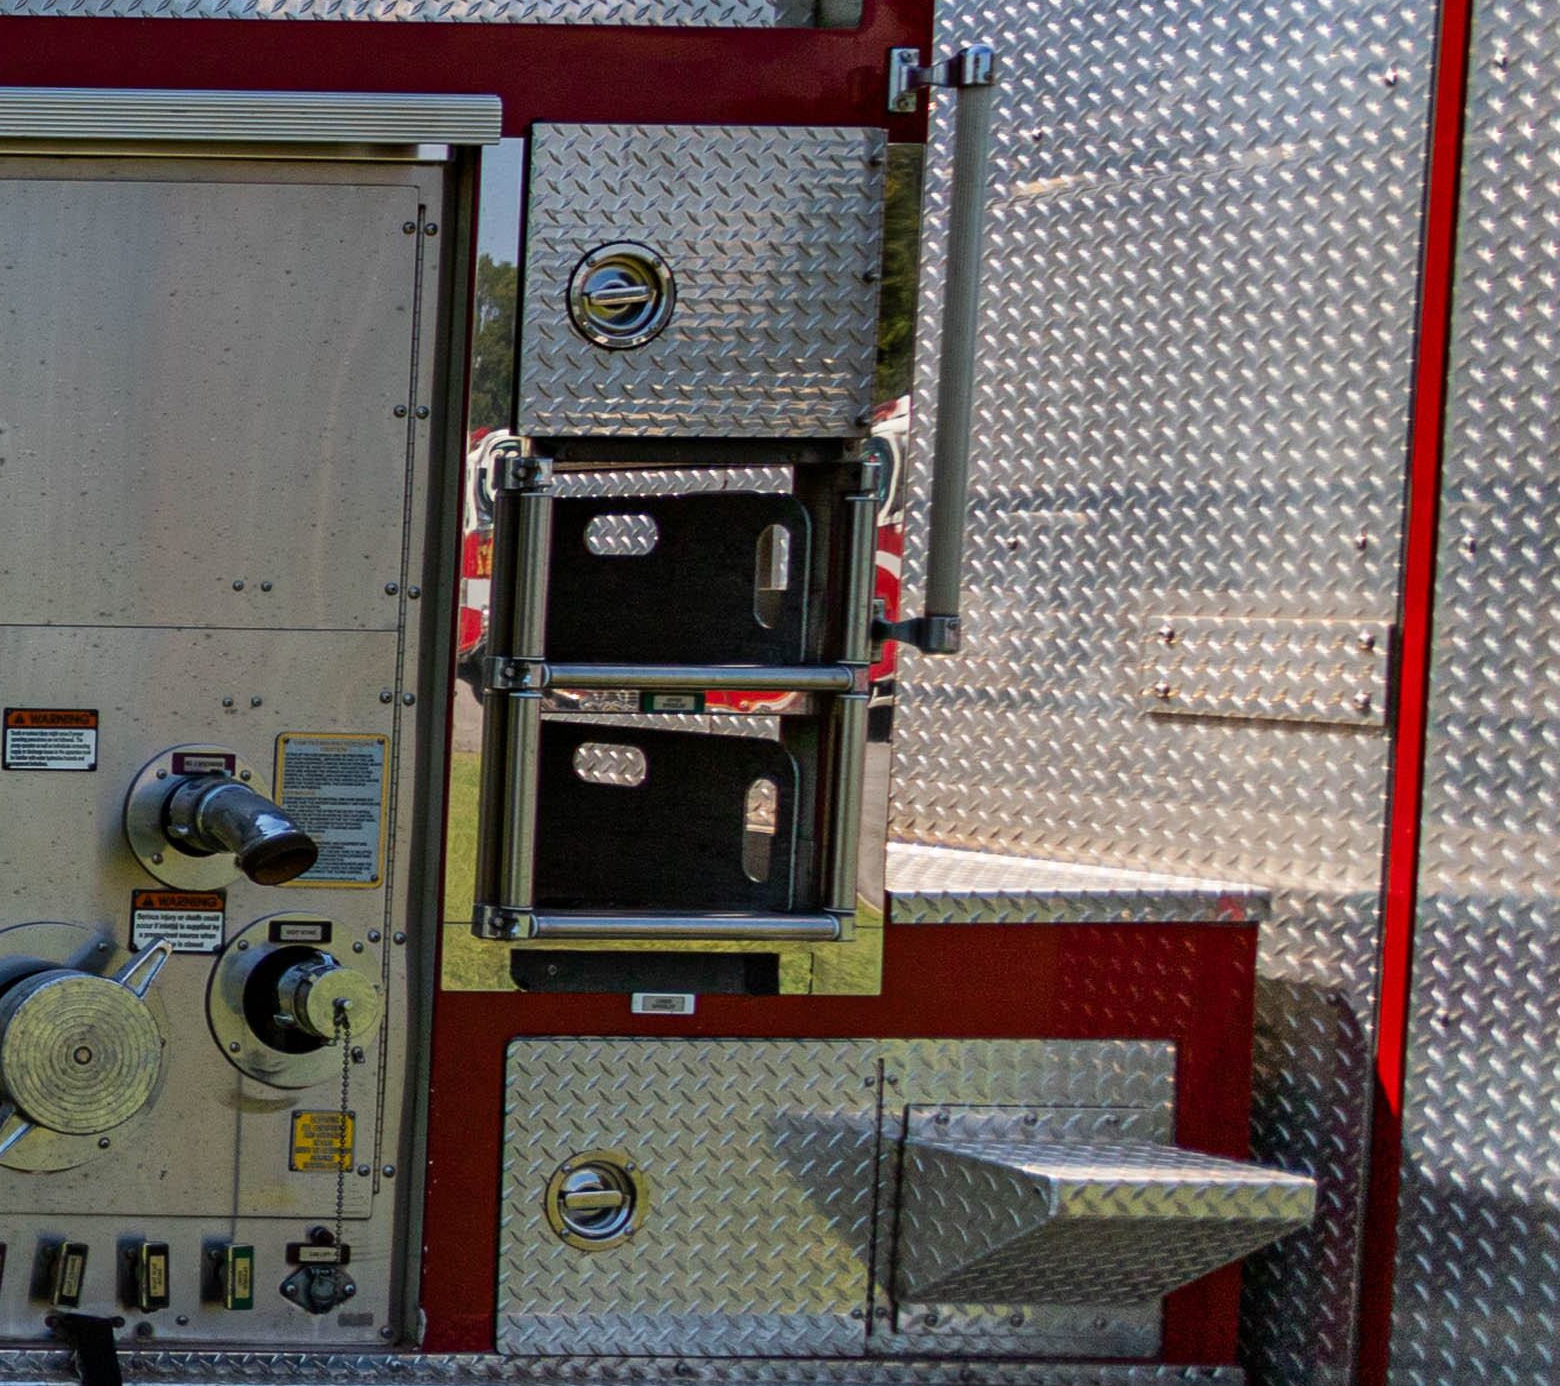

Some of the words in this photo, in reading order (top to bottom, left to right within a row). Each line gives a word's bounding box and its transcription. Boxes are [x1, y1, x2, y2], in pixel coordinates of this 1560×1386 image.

[31, 714, 89, 724] WARNING
[159, 896, 217, 907] WARNING
[160, 914, 176, 922] injury
